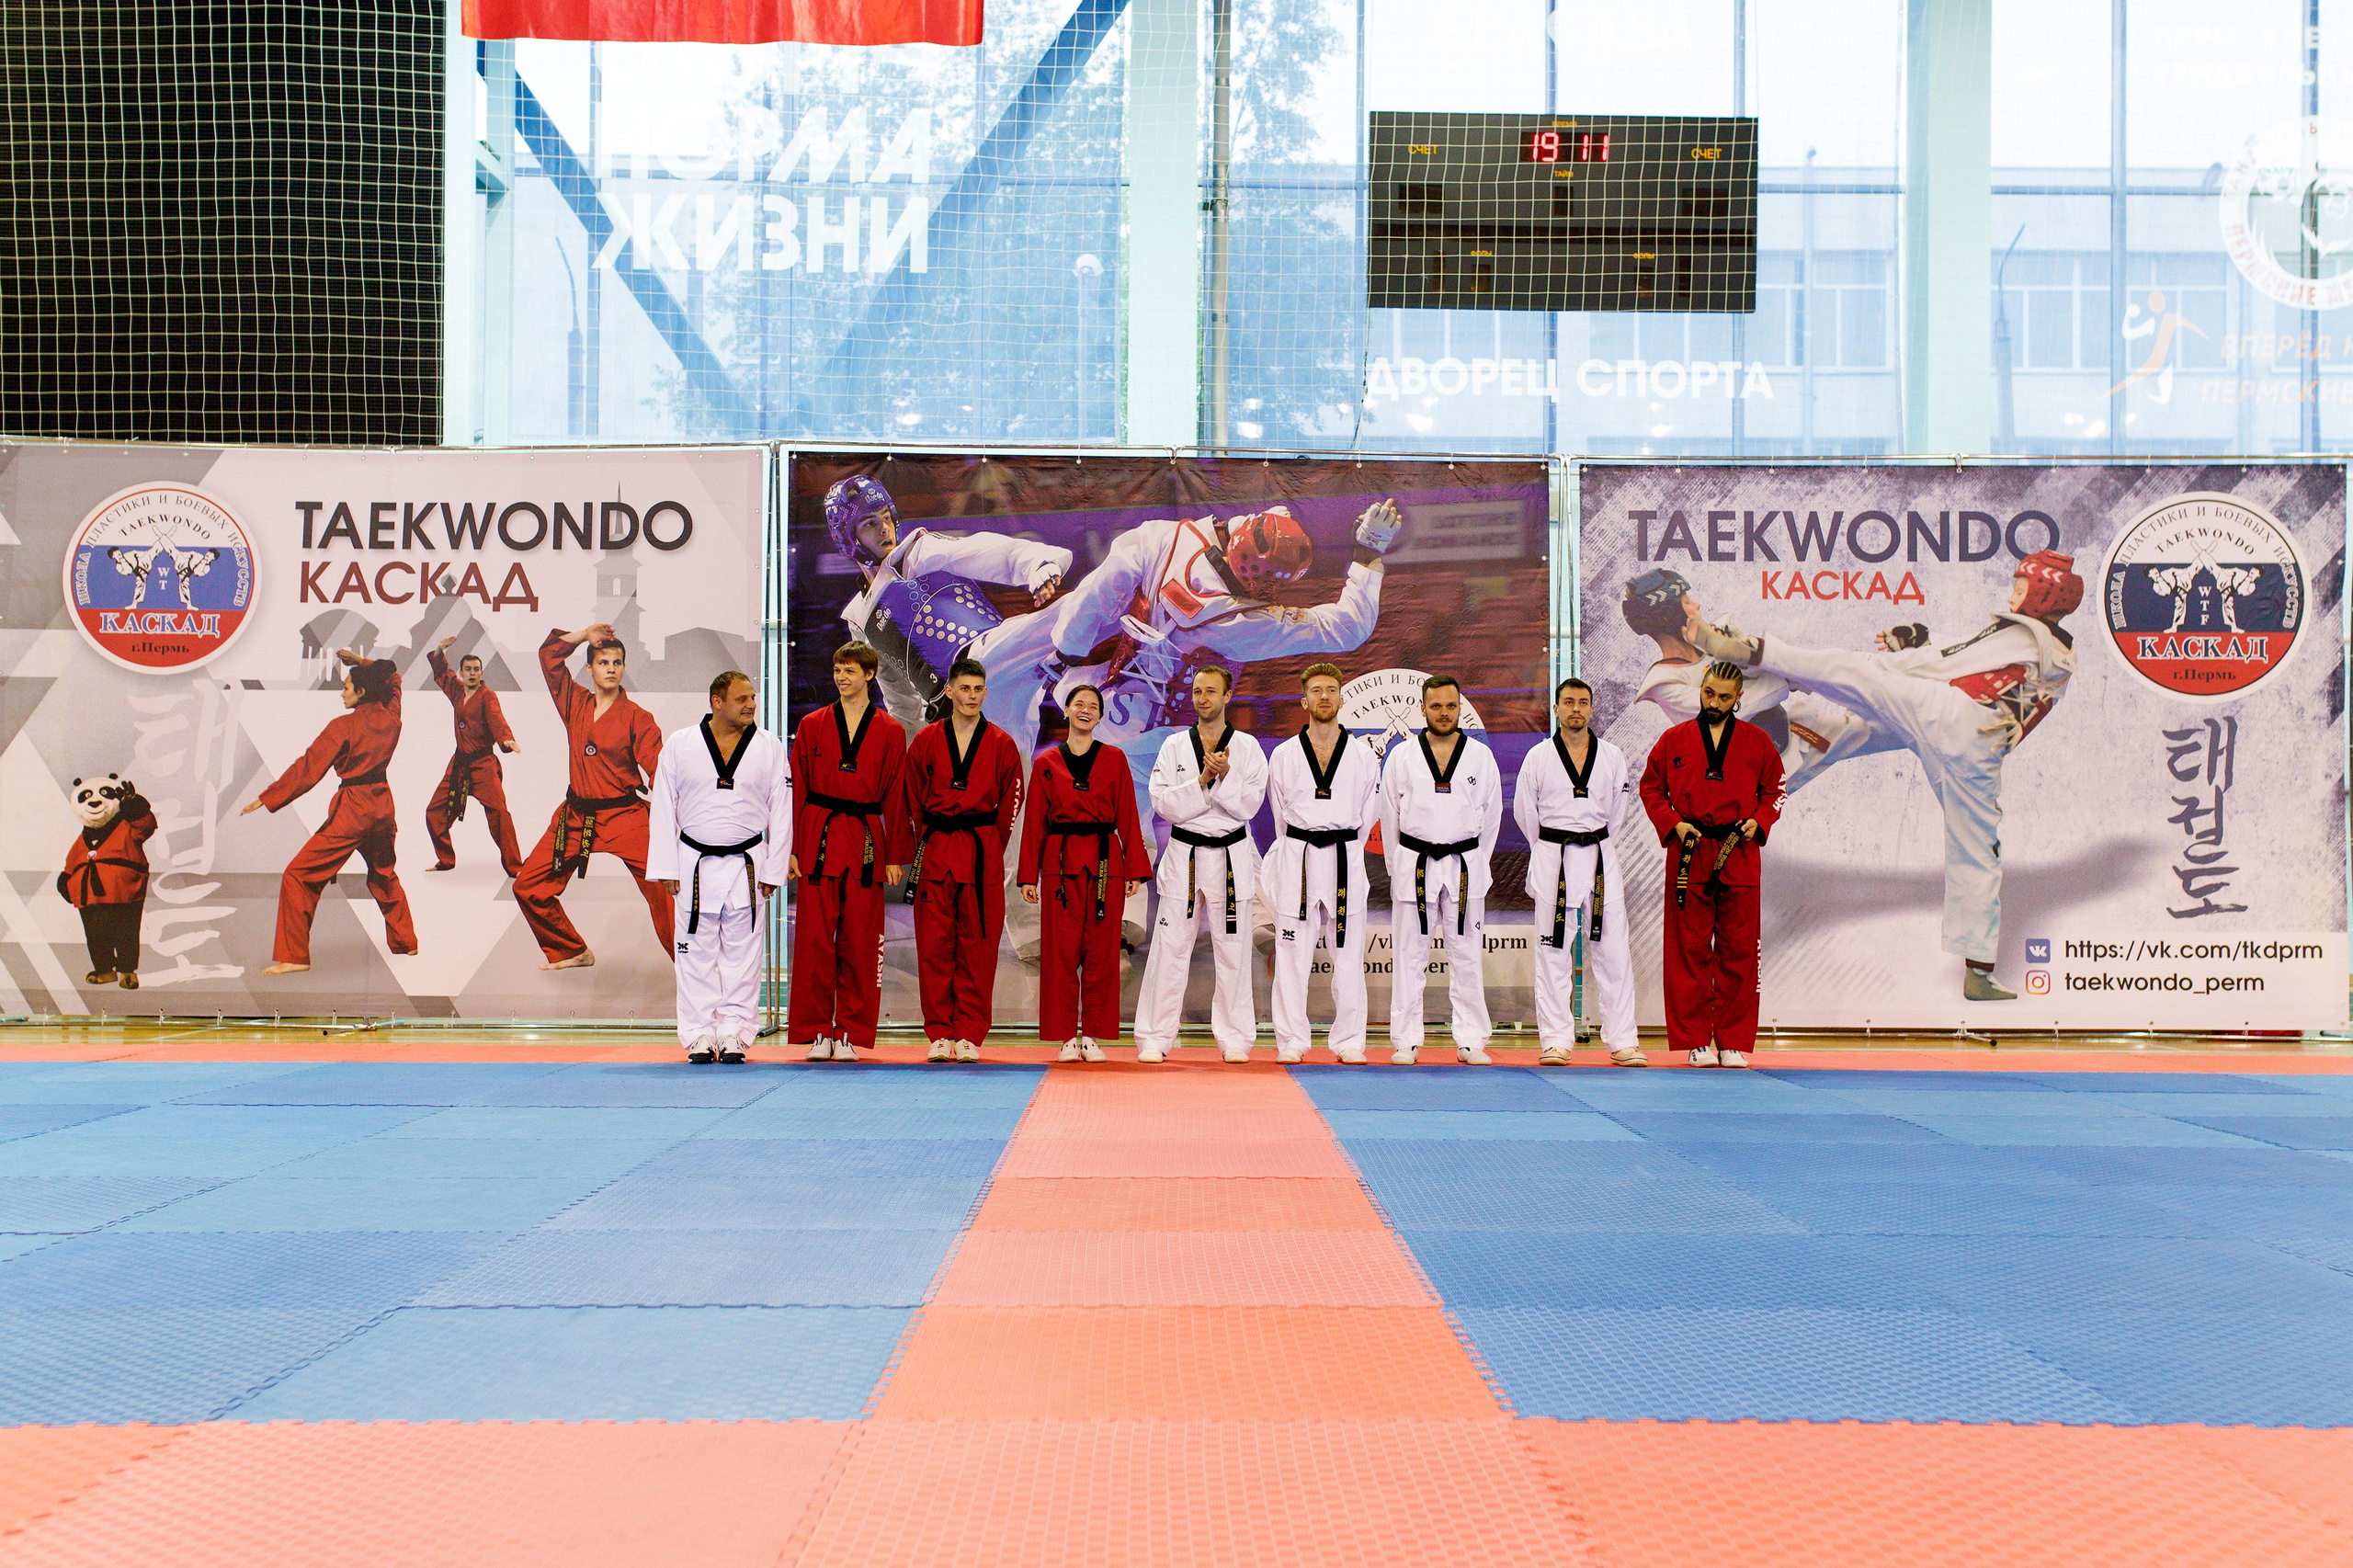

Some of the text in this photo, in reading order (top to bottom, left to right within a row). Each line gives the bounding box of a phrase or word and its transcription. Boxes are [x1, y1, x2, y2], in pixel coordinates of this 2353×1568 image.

[1407, 144, 1438, 155] СЧЕТ
[1533, 131, 1609, 163] 19 11
[1691, 148, 1722, 160] СЧЕТ
[591, 192, 929, 273] ЖИЗНИ
[1366, 358, 1774, 403] ДВОРЕЦ СПОРТА
[119, 514, 210, 540] TAEKWONDO
[295, 500, 694, 551] TAEKWONDO
[1629, 509, 2061, 562] TAEKWONDO
[75, 494, 250, 608] ШКОЛА ПЛАСТИКИ И БОЕВЫХ ИСКУССТВ
[2155, 528, 2255, 554] TAEKWONDO
[2110, 506, 2299, 630] ШКОЛА ПЛАСТИКИ И БОЕВЫХ ИСКУССТВ
[300, 561, 539, 613] КАСКАД
[1762, 571, 1925, 605] КАСКАД
[99, 612, 221, 638] КАСКАД
[2137, 636, 2268, 664] КАСКАД
[1391, 675, 1400, 684] И
[2174, 669, 2236, 682] г.Пермь
[2065, 940, 2324, 962] https://vk.com/tkdprm
[2065, 972, 2265, 995] taekwondo_perm
